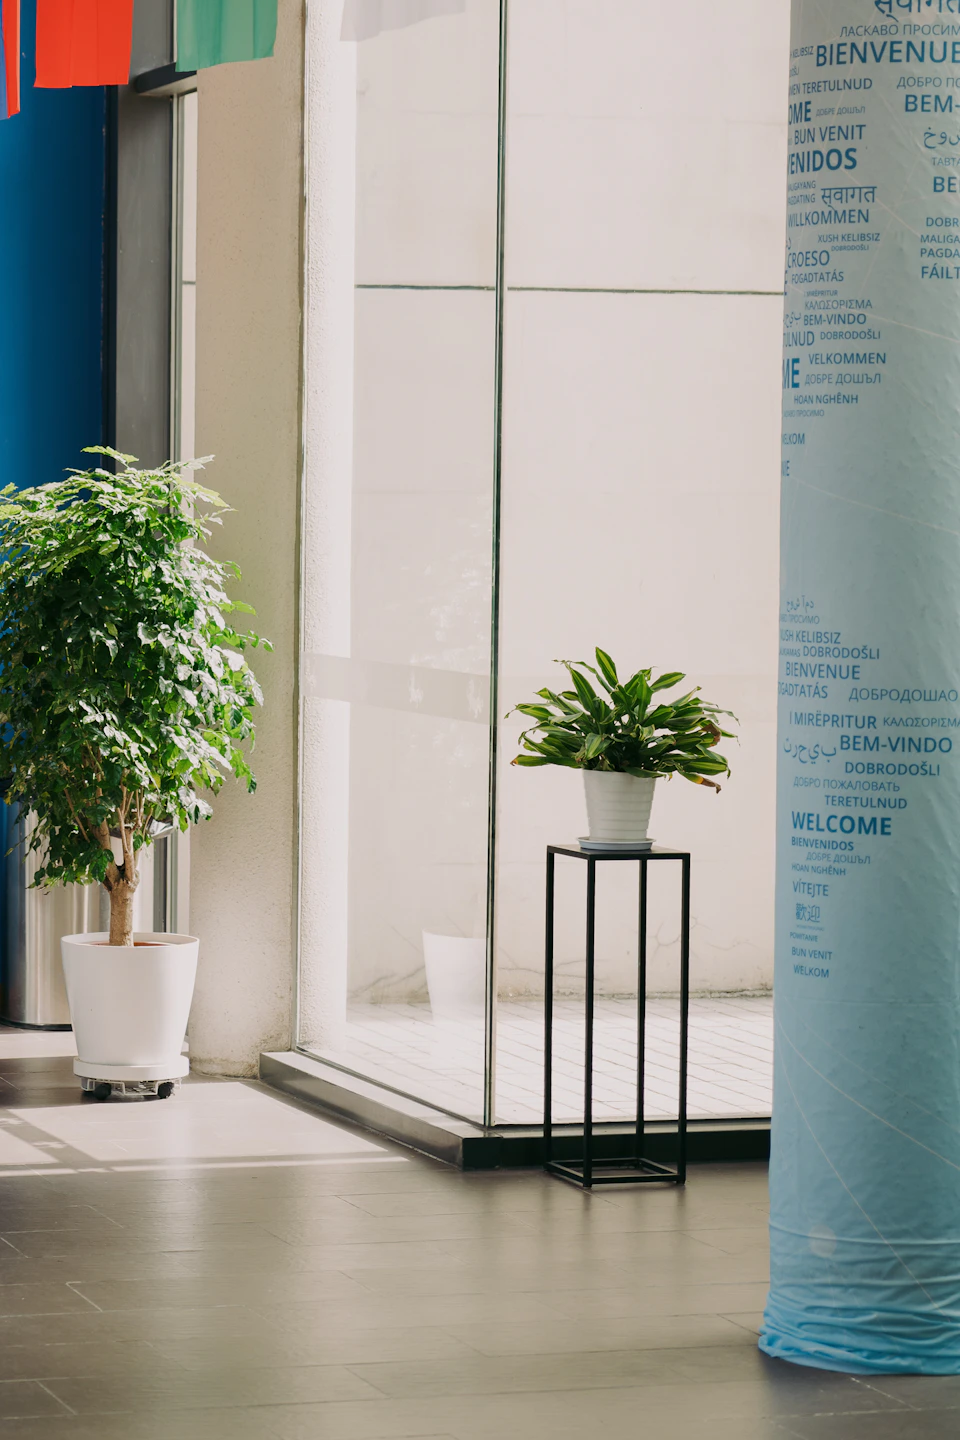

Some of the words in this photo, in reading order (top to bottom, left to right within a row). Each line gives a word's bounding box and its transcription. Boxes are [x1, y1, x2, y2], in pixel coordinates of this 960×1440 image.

[840, 24, 898, 37] ЛАСКАВО
[816, 40, 960, 67] BIENVENUE
[802, 78, 872, 94] TERETULNUD
[897, 77, 942, 90] ДОБРО
[795, 128, 815, 145] BUN
[819, 124, 866, 142] VENIT
[788, 208, 869, 228] WILLKOMMEN
[818, 234, 839, 243] XUSH
[841, 233, 880, 242] KELIBSIZ
[787, 250, 830, 269] CROESO
[791, 269, 844, 284] FOGADTATÁS
[804, 313, 867, 326] BEM-VINDO
[820, 328, 881, 340] DOBRODOŠLI
[808, 352, 886, 365] VELKOMMEN
[804, 373, 833, 386] ДОБРЕ
[835, 373, 881, 386] ДОШЪЛ
[794, 395, 814, 404] HOAN
[815, 392, 859, 404] NGHÊNH
[796, 630, 841, 645] KELIBSIZ
[803, 645, 880, 659] DOBRODOŠLI
[786, 662, 861, 680] BIENVENUE
[849, 687, 959, 704] ДОБРОДОШАО
[794, 710, 877, 729] MIRËPRITUR
[840, 735, 952, 753] BEM-VINDO
[845, 761, 940, 776] DOBRODOŠLI
[793, 776, 821, 788] ДОБРО
[823, 779, 900, 792] ПОЖАЛОВАТЬ
[825, 795, 908, 809] TERETULNUD
[791, 811, 892, 836] WELCOME
[791, 836, 854, 851] BIENVENIDOS
[806, 852, 832, 862] ДОБРЕ
[833, 854, 871, 865] ДОШЪЛ
[791, 863, 809, 873] HOAN
[811, 865, 846, 876] NGHÊNH
[792, 878, 829, 898] VÍTEJTE
[792, 946, 807, 957] BUN
[808, 949, 833, 960] VENIT
[793, 964, 830, 978] WELKOM
